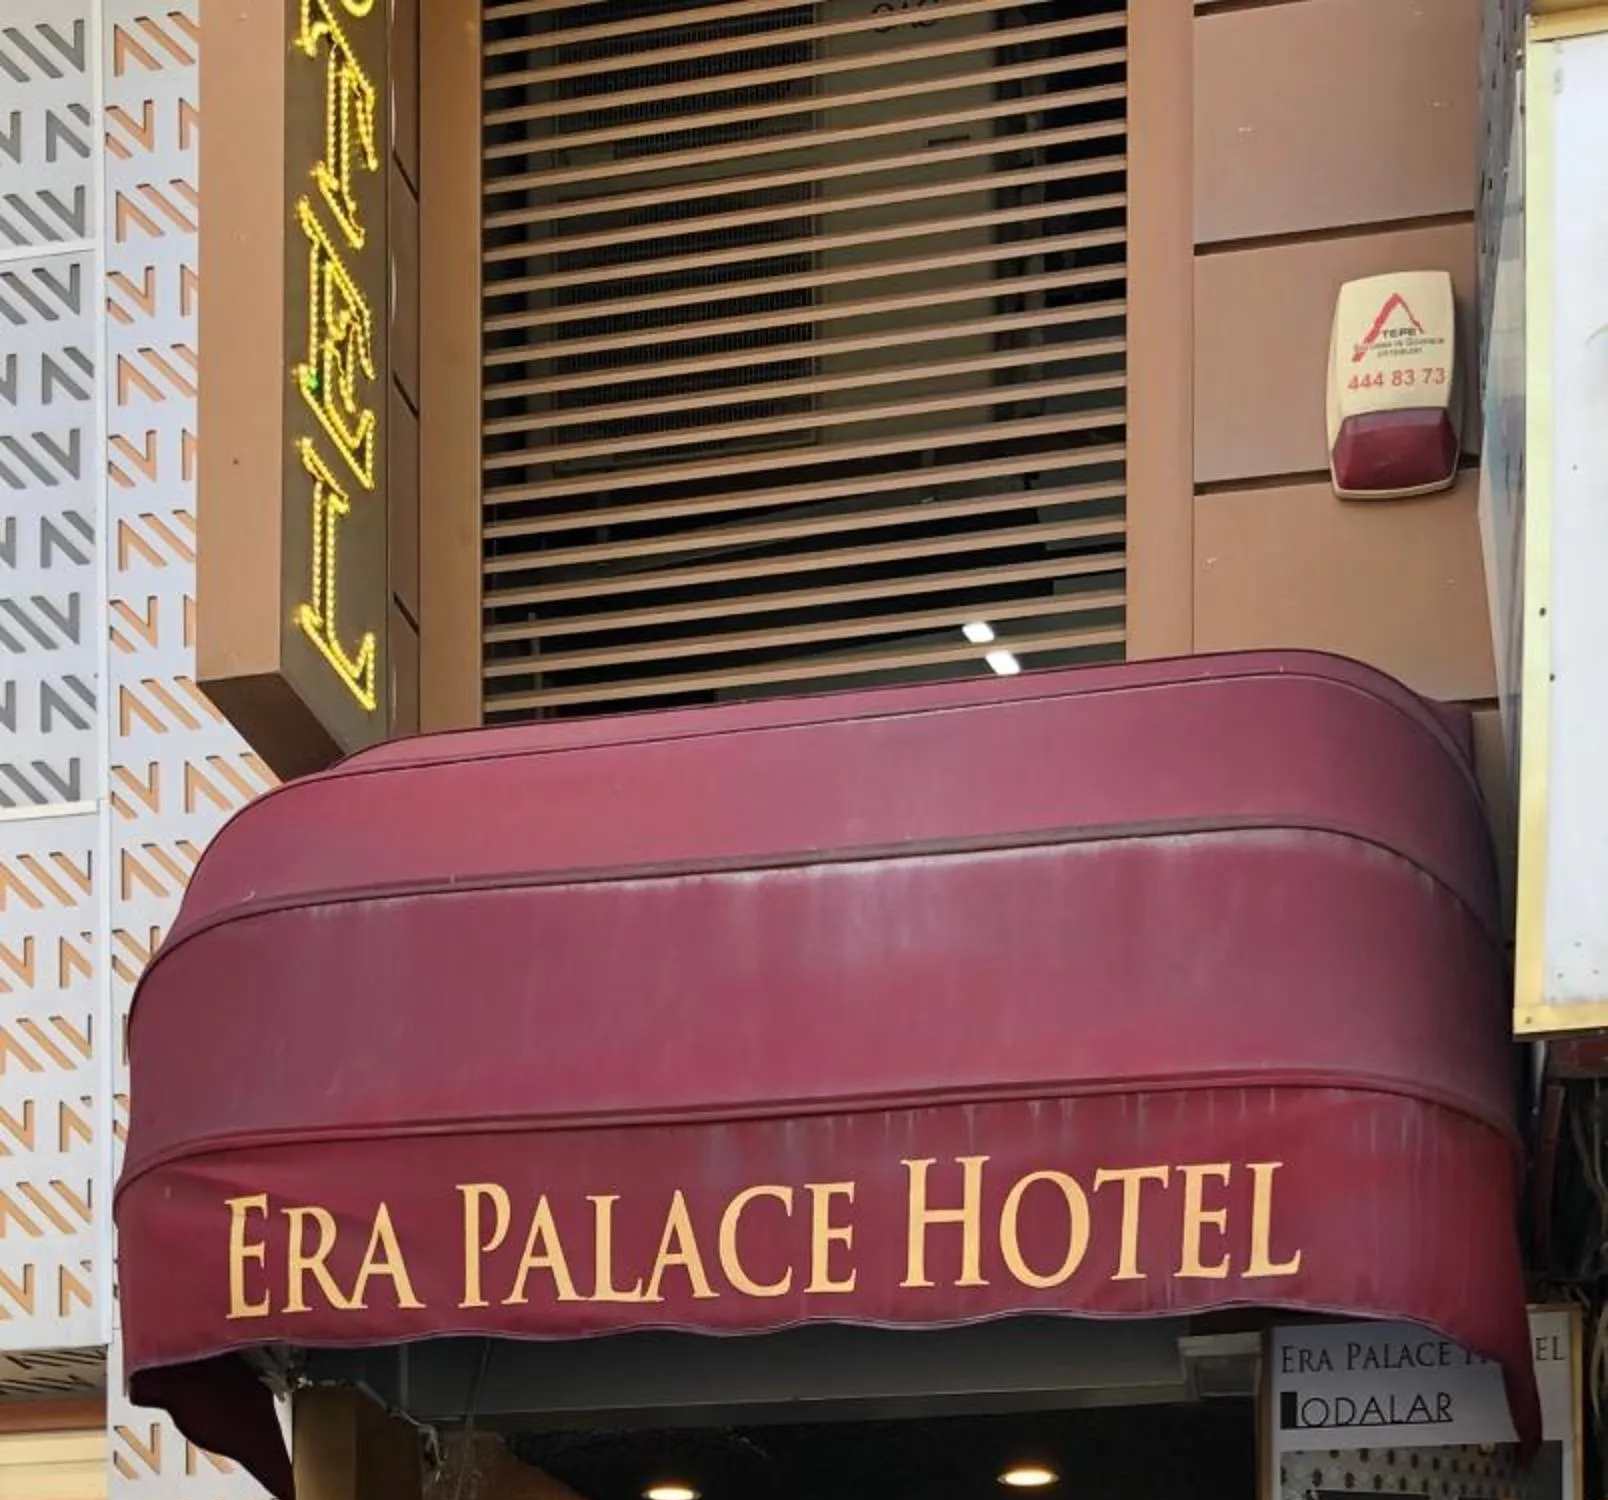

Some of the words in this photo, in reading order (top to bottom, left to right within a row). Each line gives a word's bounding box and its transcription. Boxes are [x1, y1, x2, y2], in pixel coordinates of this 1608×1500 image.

[1382, 328, 1416, 337] TEPE
[293, 0, 377, 711] TEL
[1347, 373, 1384, 389] 444
[1391, 369, 1414, 386] 83
[1422, 367, 1445, 384] 73
[225, 1193, 426, 1318] ERA
[455, 1182, 857, 1308] PALACE
[900, 1155, 1301, 1288] HOTEL
[1282, 1346, 1333, 1374] ERA
[1347, 1341, 1449, 1370] PALACE
[1301, 1392, 1453, 1427] ODALAR
